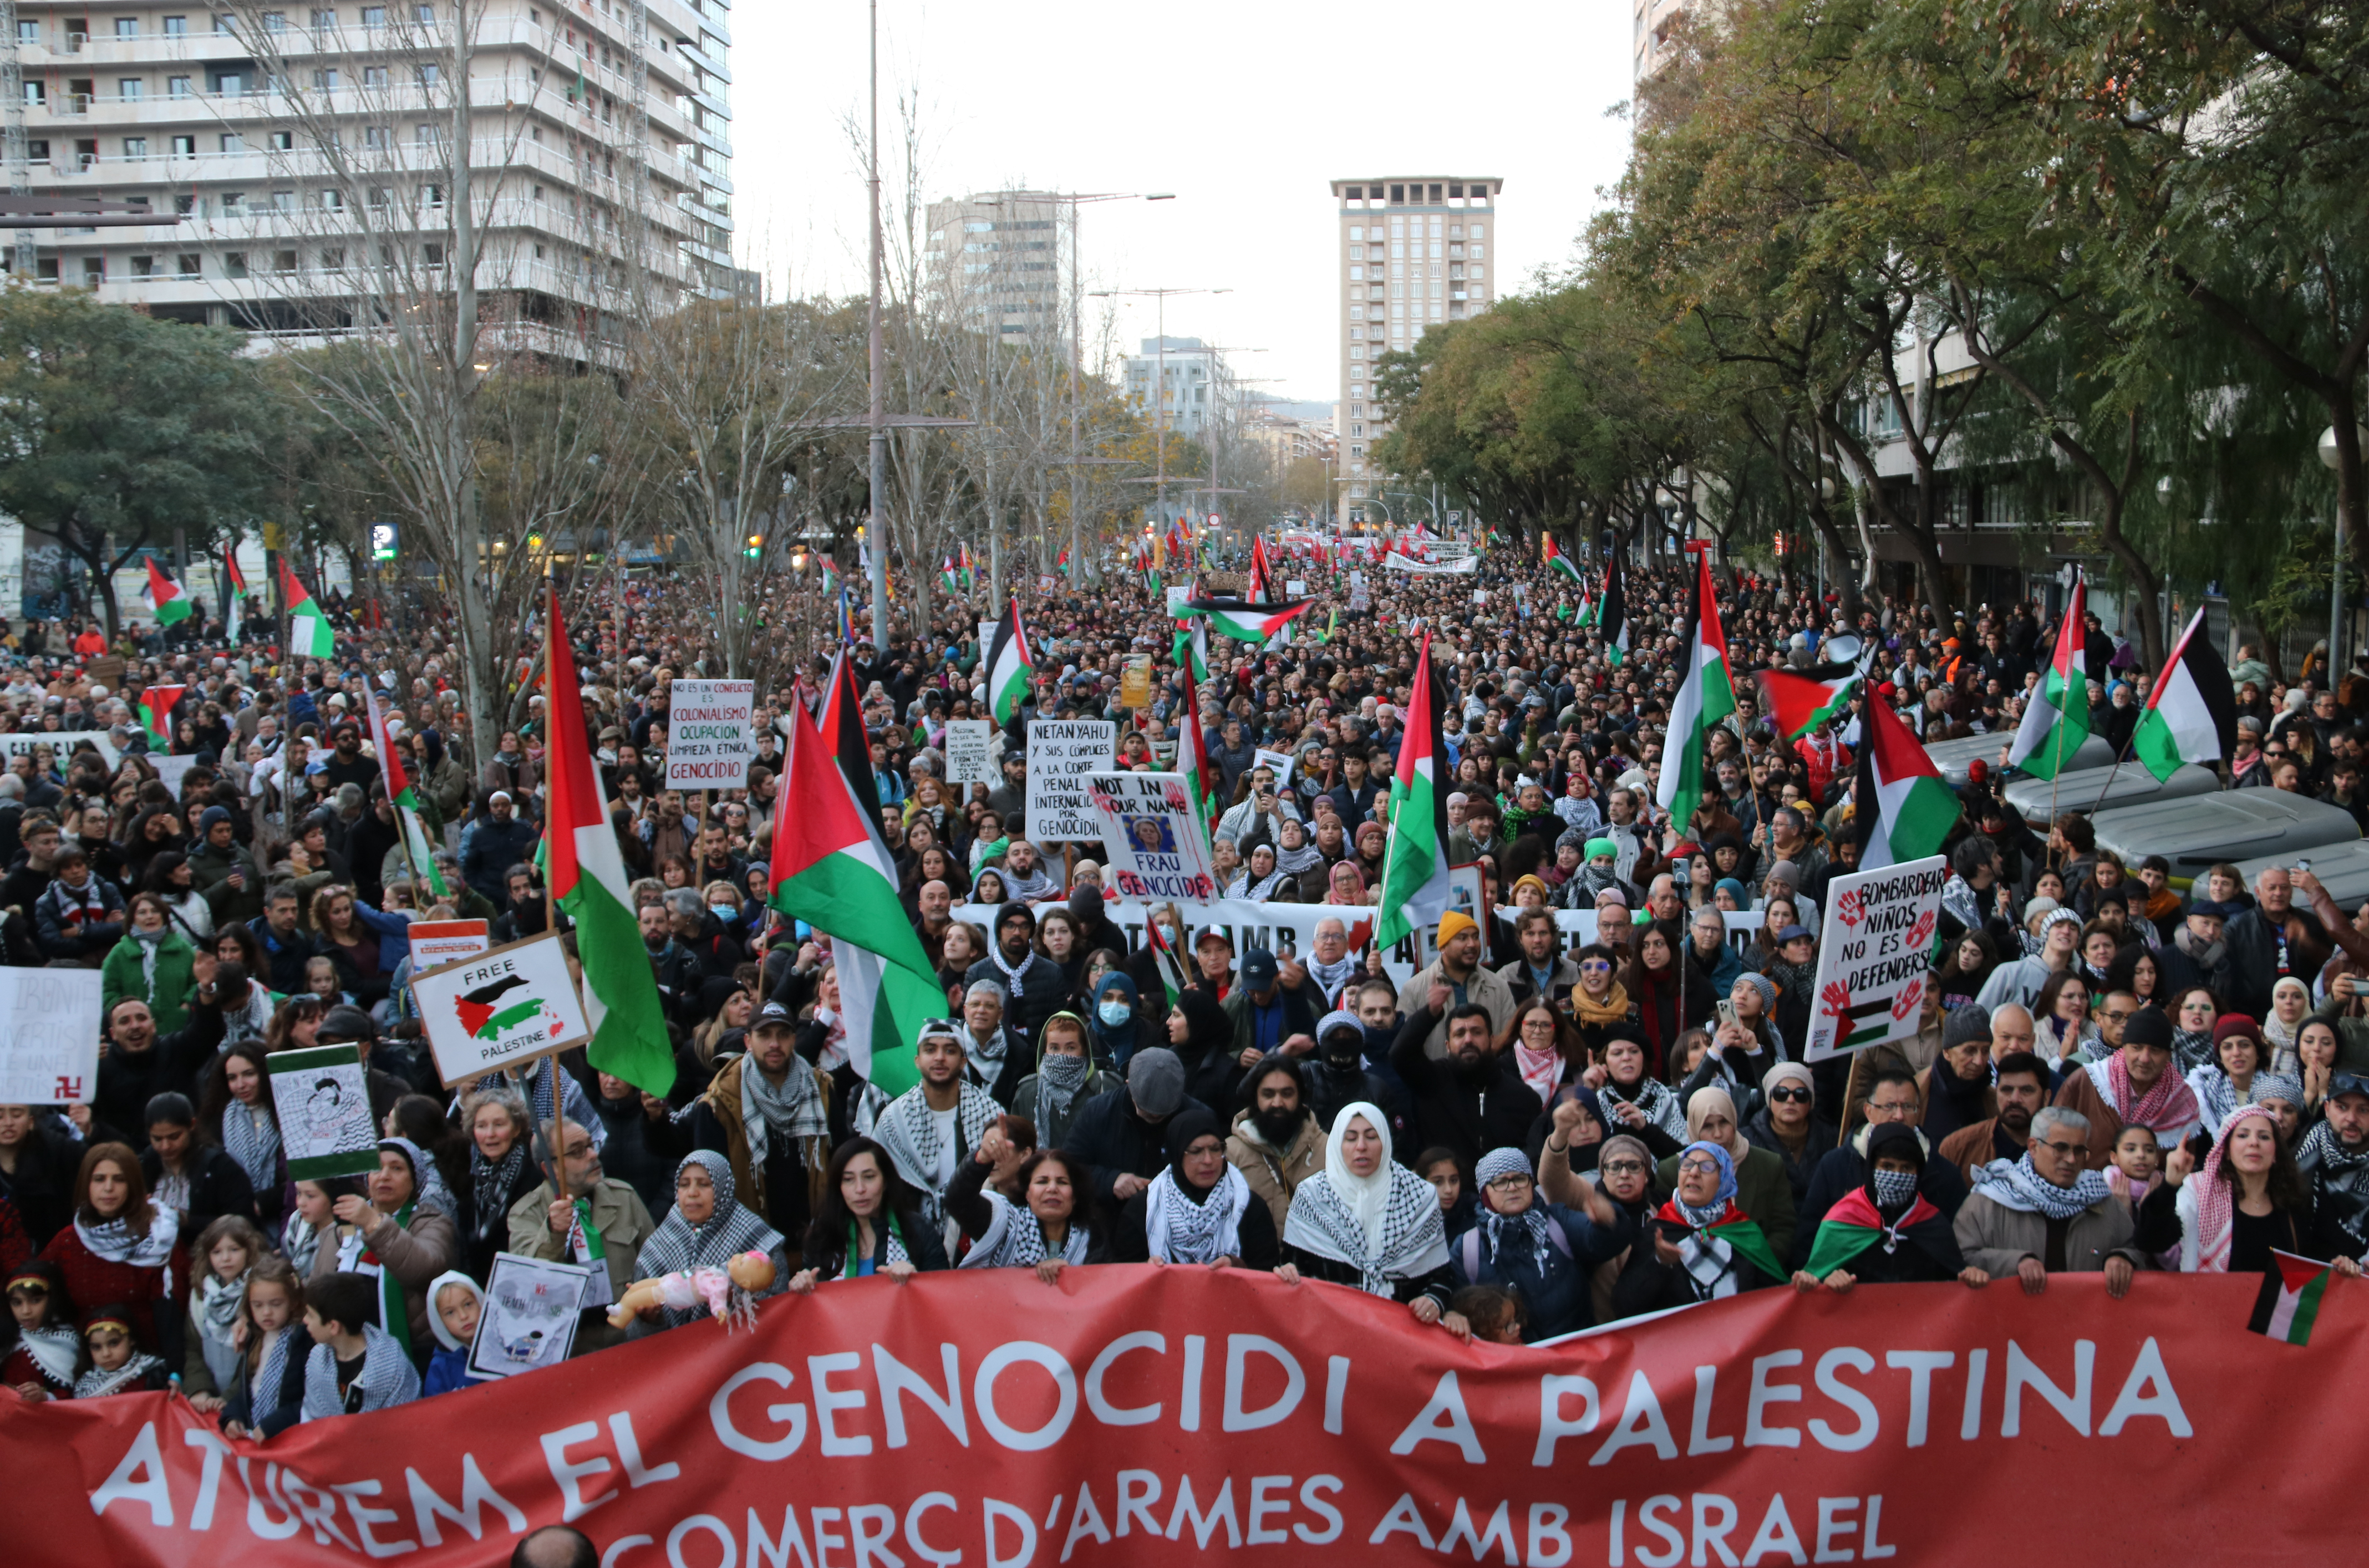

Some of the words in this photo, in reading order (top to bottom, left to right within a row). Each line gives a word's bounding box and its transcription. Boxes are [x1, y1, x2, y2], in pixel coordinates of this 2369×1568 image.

[1450, 513, 1458, 523] P
[1393, 555, 1405, 568] NO
[1423, 561, 1453, 571] GUERRA
[1217, 573, 1248, 583] STOP
[673, 683, 685, 693] NO
[688, 683, 697, 693] ES
[701, 683, 711, 693] UN
[714, 681, 753, 693] CONFLICTO
[702, 694, 714, 702] ES
[680, 723, 739, 740] OCUPACIÓN
[1034, 724, 1109, 740] NETANYAHU
[669, 744, 711, 755] LIMPIEZA
[717, 740, 748, 754] ÉTNICA
[1032, 745, 1039, 757] Y
[1045, 745, 1063, 757] SUS
[1262, 752, 1286, 762] PALESTINE
[670, 759, 741, 779] GENOCIDIO
[1033, 765, 1041, 775] A
[1048, 765, 1059, 775] LA
[1043, 777, 1084, 792] PENAL
[1092, 777, 1124, 795] NOT
[1138, 776, 1162, 796] IN
[1059, 809, 1079, 819] POR
[1109, 798, 1140, 813] OUR
[1146, 799, 1189, 815] NAME
[1135, 854, 1181, 872] FRAU
[1117, 873, 1209, 899] GENOCIDE
[1864, 902, 1918, 935] NIÑOS
[1841, 939, 1865, 963] NO
[1879, 933, 1900, 956] ES
[463, 959, 516, 985] FREE
[481, 1030, 545, 1060] PALESTINE
[535, 1282, 547, 1296] WE
[502, 1295, 526, 1311] TEACH
[90, 1421, 528, 1558] ATUREM
[540, 1412, 681, 1522] EL
[708, 1331, 1349, 1462] GENOCIDI
[1390, 1369, 1486, 1464] A
[1532, 1336, 2194, 1467] PALESTINA
[601, 1490, 962, 1568] COMERÇ
[982, 1468, 1344, 1568] D'ARMES
[1369, 1491, 1573, 1566] AMB
[1609, 1491, 1897, 1568] ISRAEL
